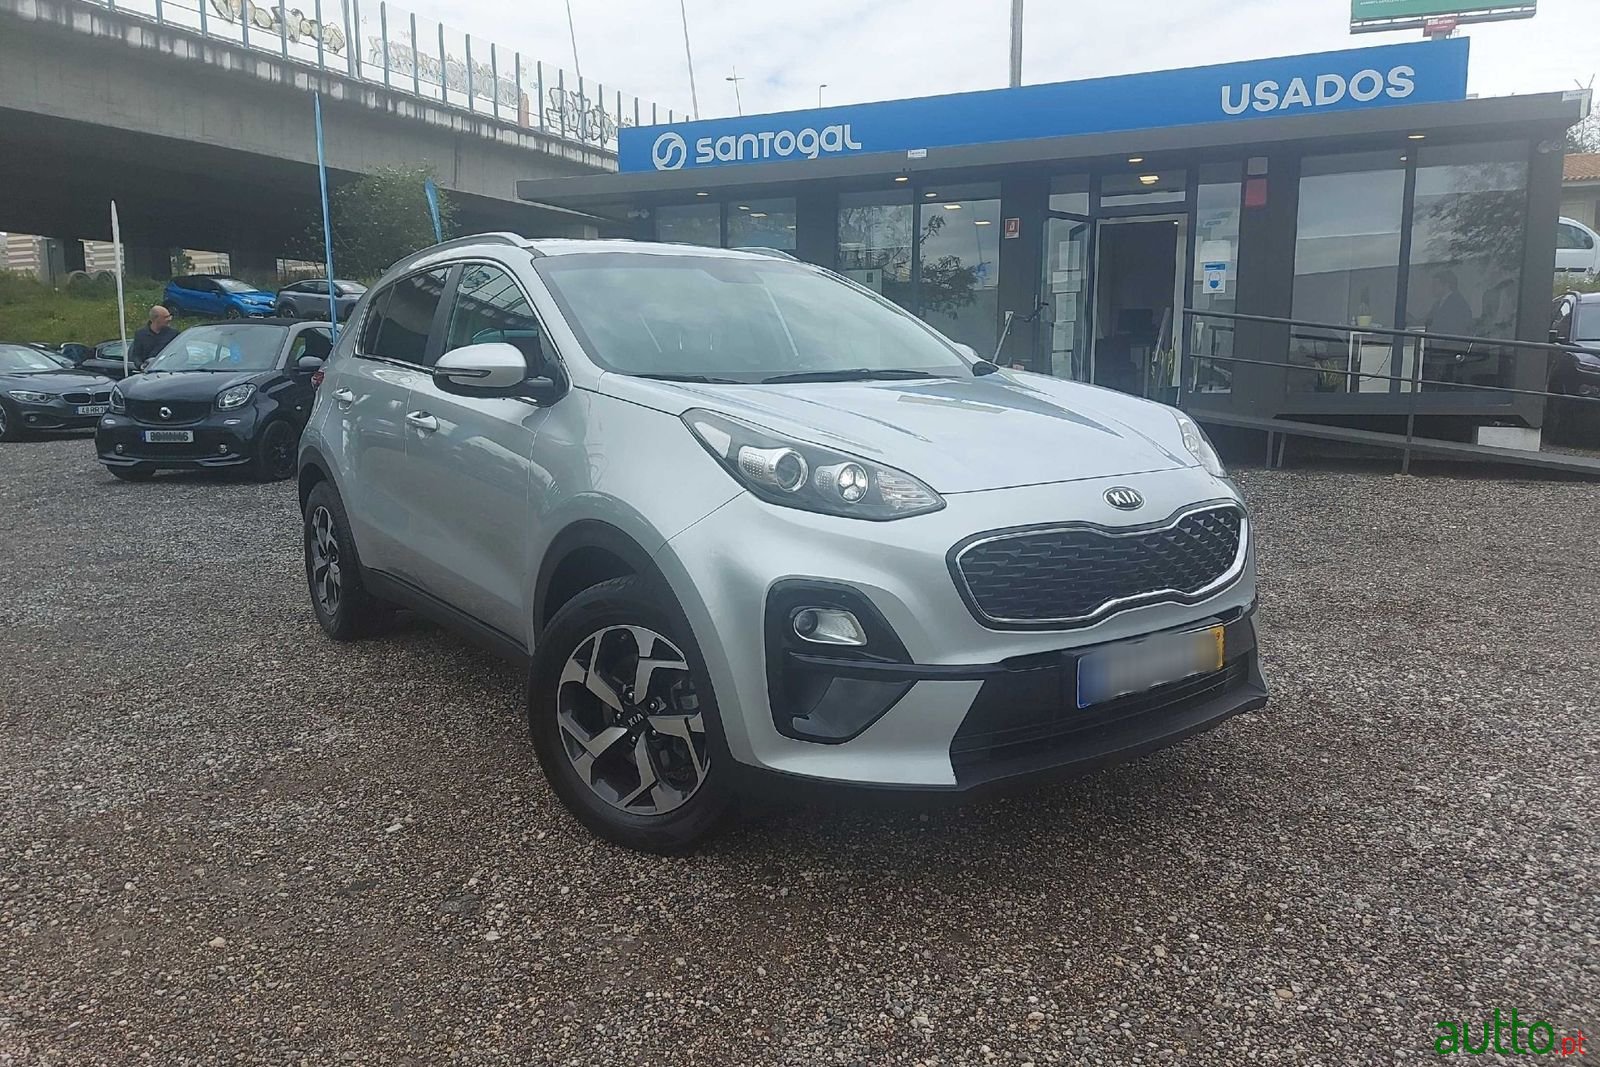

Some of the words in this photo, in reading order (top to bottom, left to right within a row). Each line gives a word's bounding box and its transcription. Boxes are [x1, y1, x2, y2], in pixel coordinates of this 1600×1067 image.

[1221, 65, 1415, 115] USADOS
[1109, 490, 1141, 506] KIA
[627, 713, 644, 727] KIA
